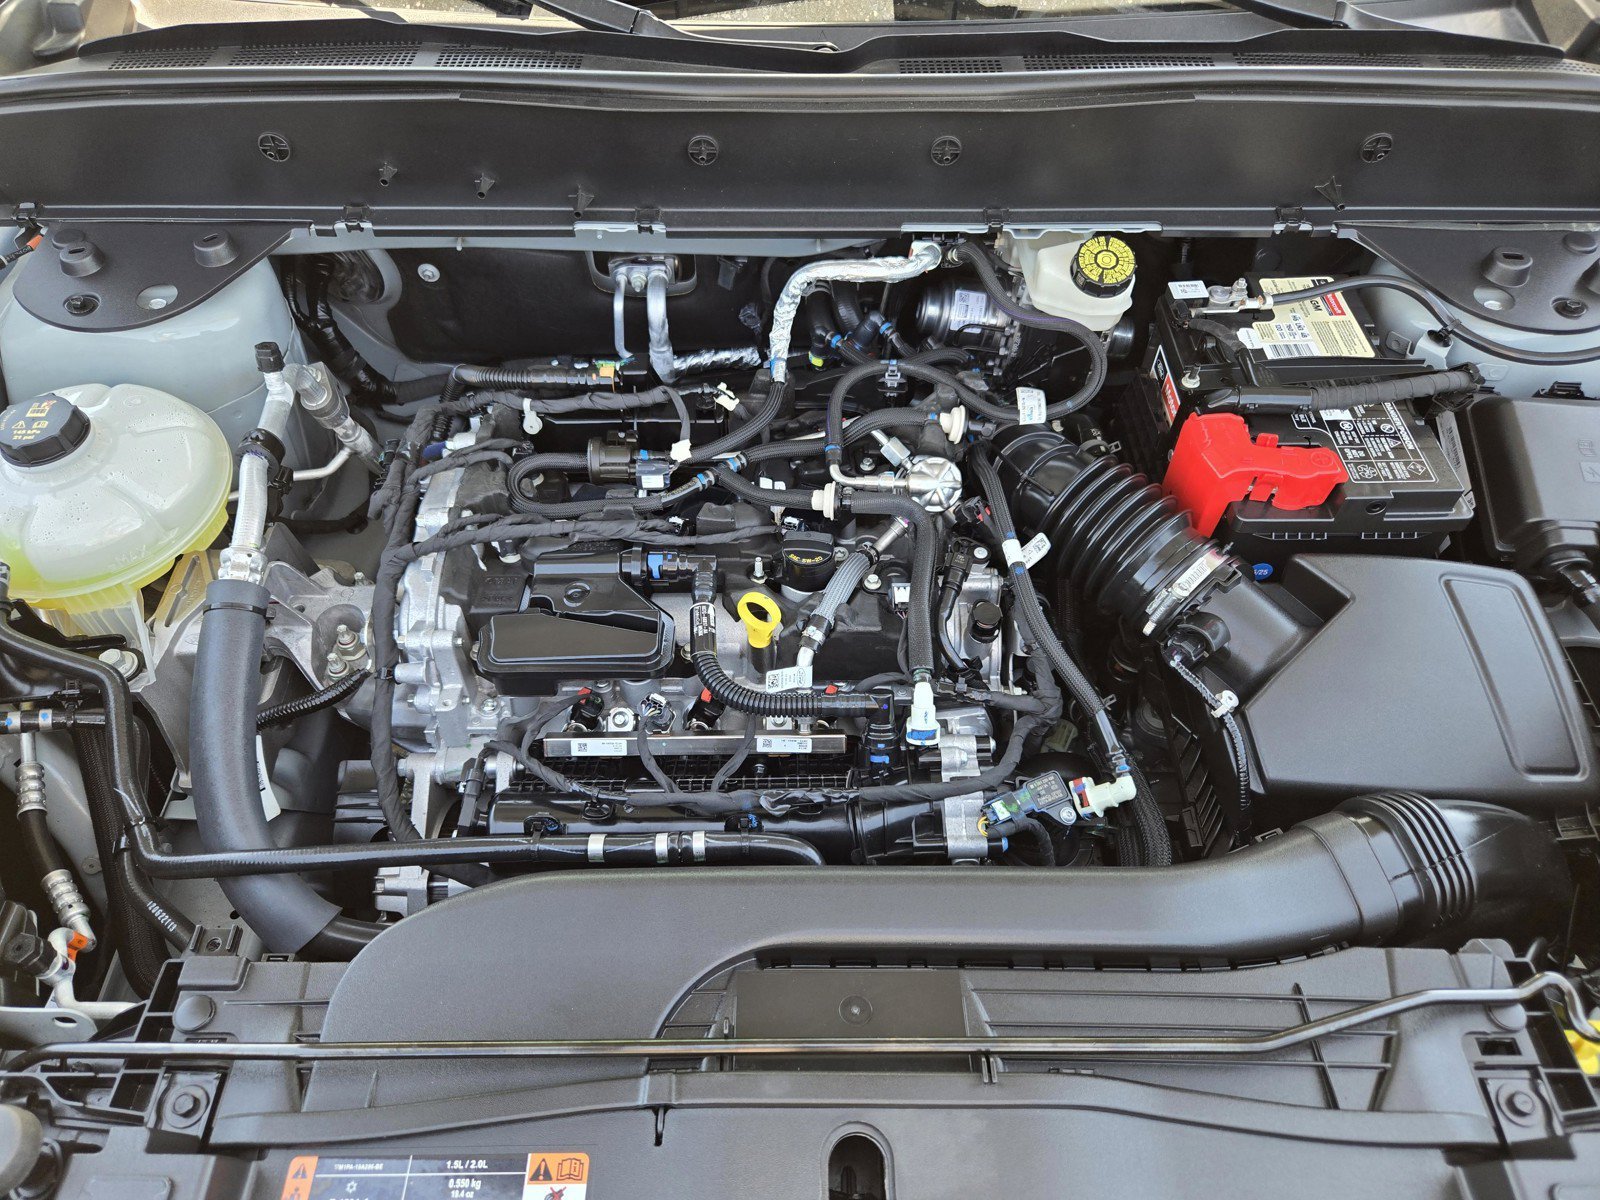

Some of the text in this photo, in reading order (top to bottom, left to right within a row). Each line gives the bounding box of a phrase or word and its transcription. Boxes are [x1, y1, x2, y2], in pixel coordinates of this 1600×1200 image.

[788, 553, 800, 562] SAE
[446, 1160, 464, 1169] 1.5L
[470, 1160, 488, 1169] 2.0L
[448, 1178, 482, 1191] 0.550 kg
